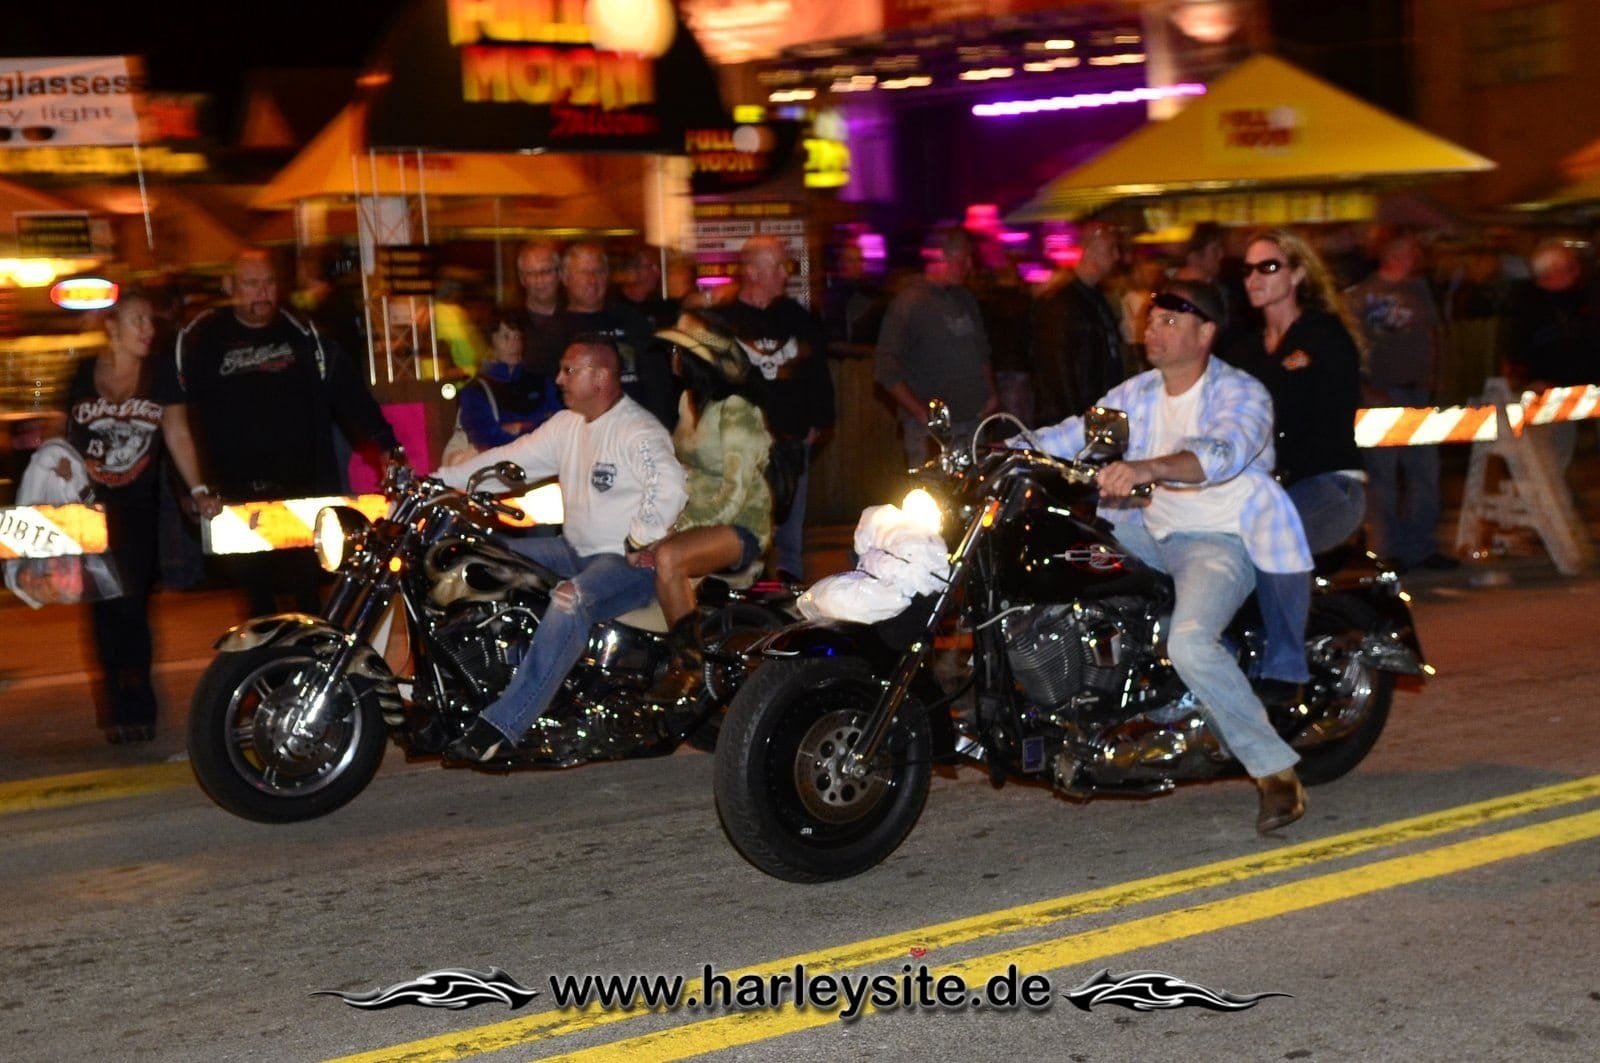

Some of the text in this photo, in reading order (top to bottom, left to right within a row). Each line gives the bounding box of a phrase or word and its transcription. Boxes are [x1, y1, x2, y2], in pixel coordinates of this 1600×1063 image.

[0, 71, 131, 101] glasses
[461, 46, 656, 110] MOON
[42, 105, 112, 122] light
[72, 398, 119, 424] Bike
